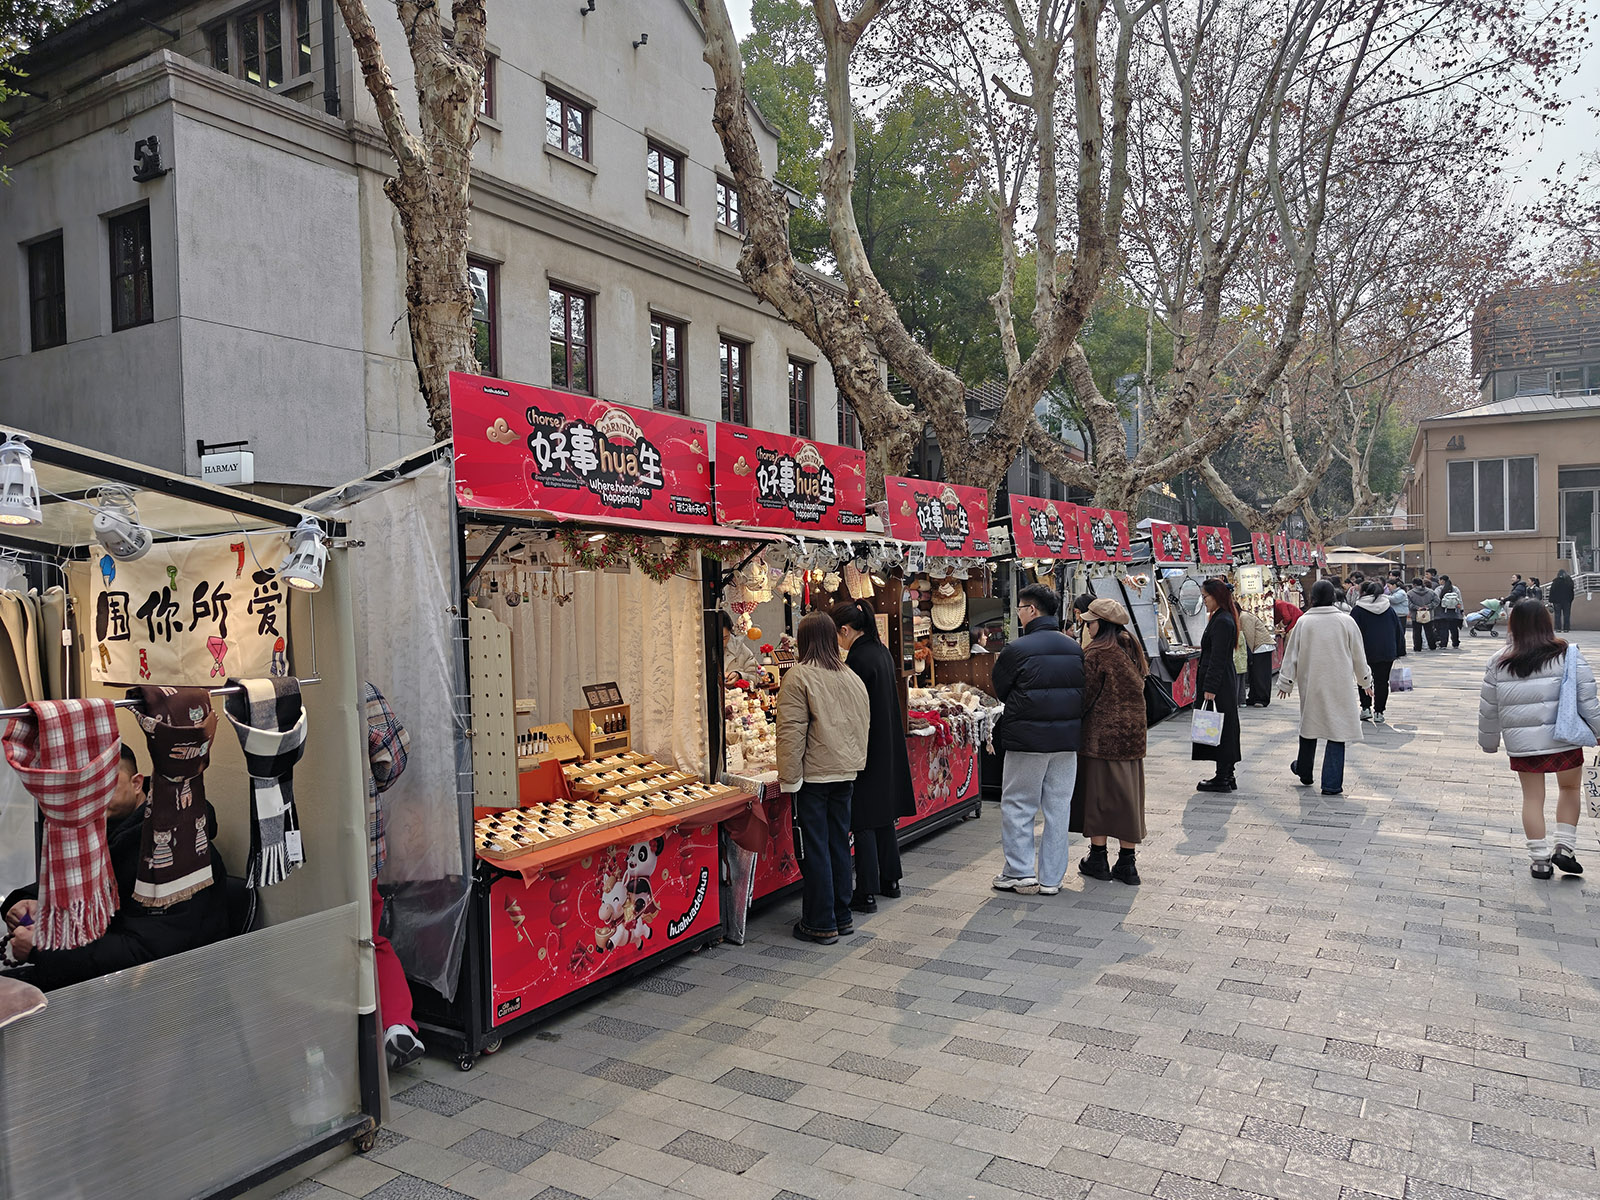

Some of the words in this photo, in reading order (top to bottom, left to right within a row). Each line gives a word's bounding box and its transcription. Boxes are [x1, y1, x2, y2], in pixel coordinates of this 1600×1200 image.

[601, 422, 639, 439] CARNIVAL
[204, 463, 239, 473] HARMAY
[589, 478, 615, 491] Where
[615, 480, 650, 496] happiness
[602, 490, 640, 506] happening
[95, 566, 283, 642] 围你所爱
[669, 871, 708, 937] huahuadehua
